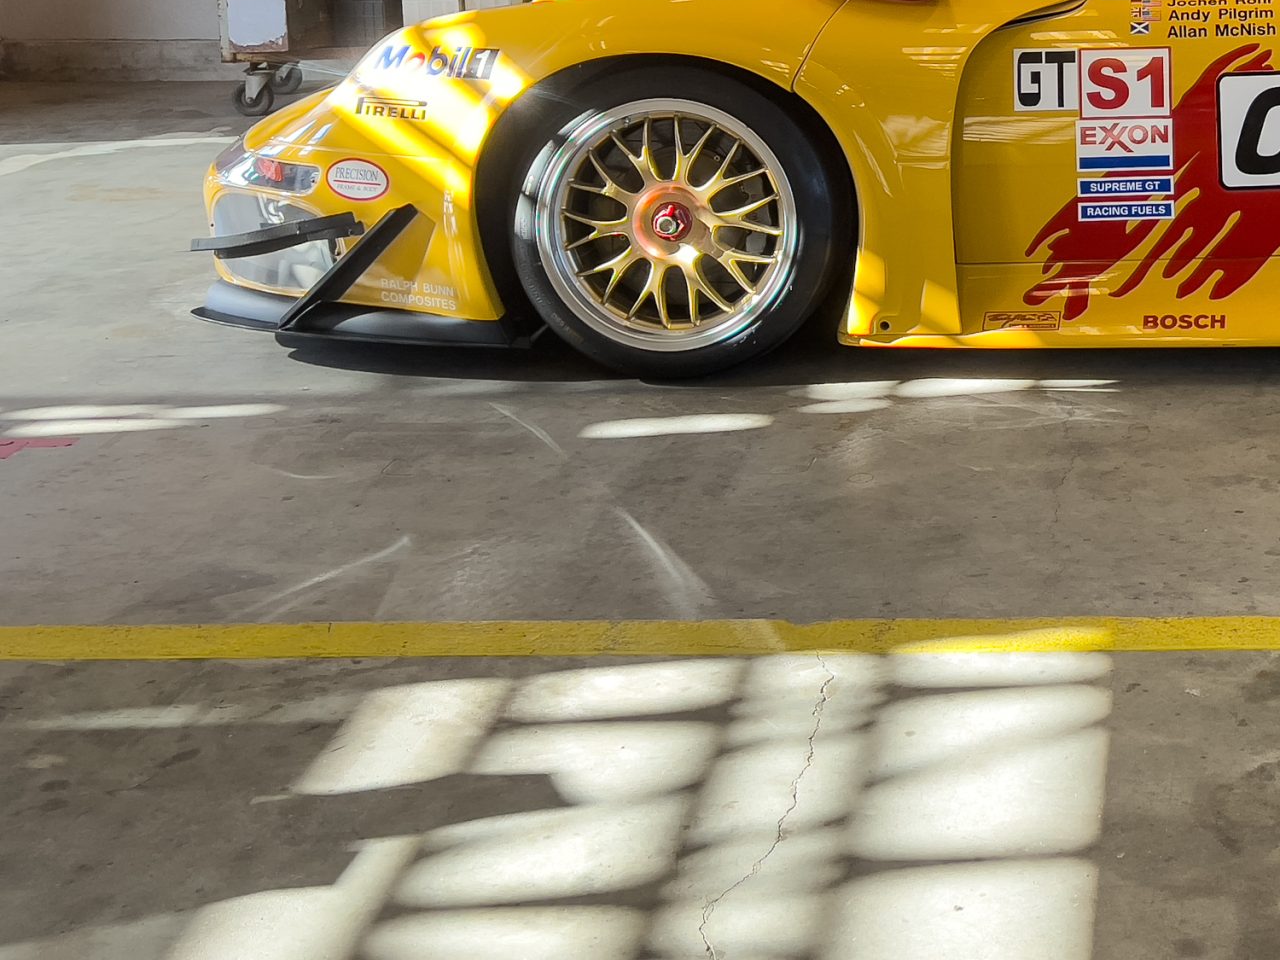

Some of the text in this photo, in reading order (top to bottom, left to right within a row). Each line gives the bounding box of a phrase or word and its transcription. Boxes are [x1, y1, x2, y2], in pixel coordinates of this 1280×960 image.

[1168, 8, 1274, 23] Andy Pilgrim
[1167, 23, 1277, 38] Allan McNish
[375, 45, 472, 78] Mobil
[1017, 51, 1165, 110] GT S1
[355, 97, 428, 120] PIRELLI
[1080, 123, 1169, 153] EXXON
[335, 167, 379, 181] PRECISION
[1090, 181, 1161, 192] SUPREME GT
[1087, 205, 1166, 216] RACING FUELS
[381, 278, 454, 297] RALPH BUNN
[381, 291, 457, 311] COMPOSITES
[1142, 314, 1226, 329] BOSCH
